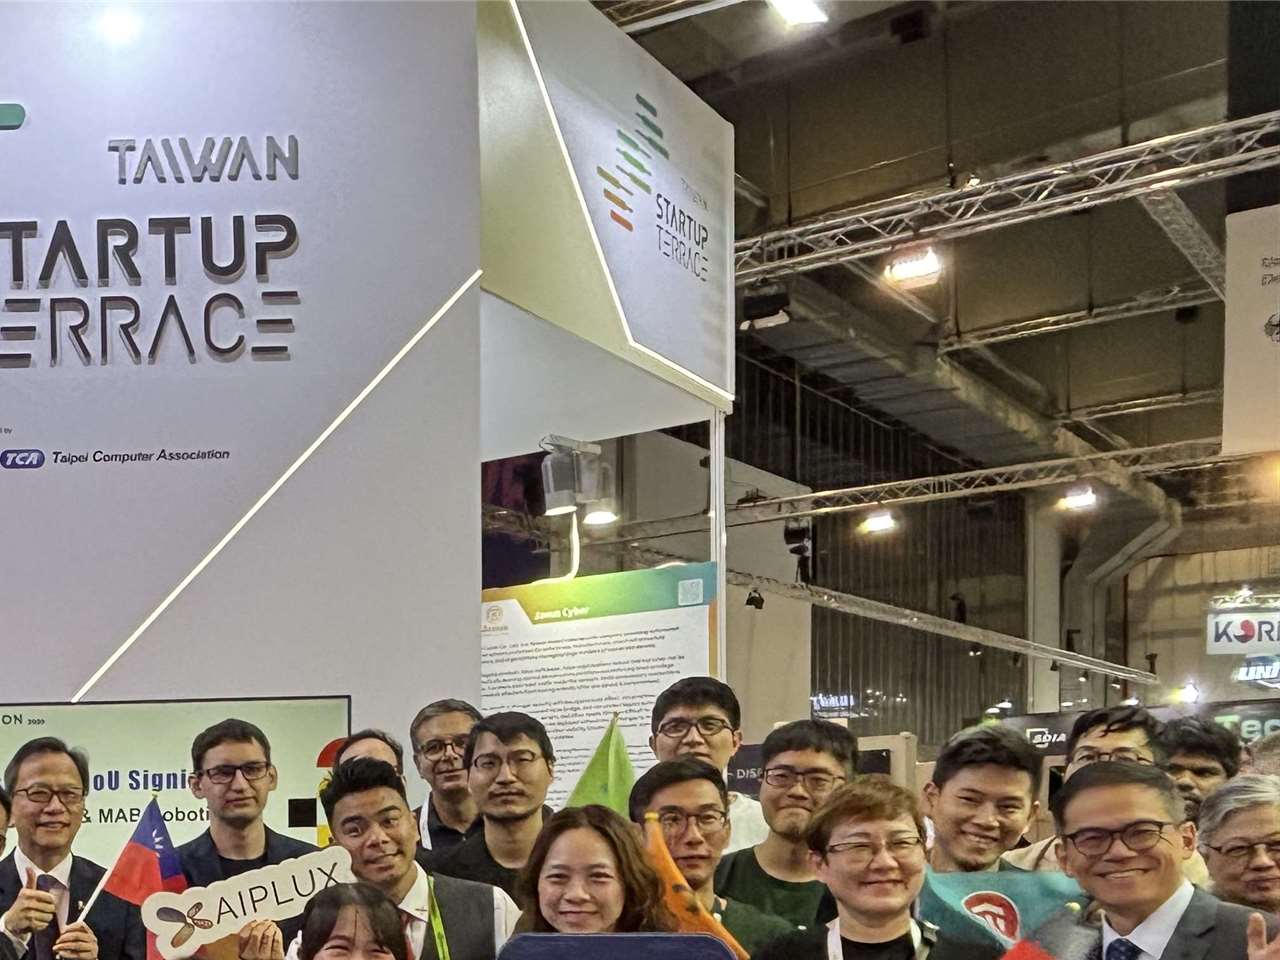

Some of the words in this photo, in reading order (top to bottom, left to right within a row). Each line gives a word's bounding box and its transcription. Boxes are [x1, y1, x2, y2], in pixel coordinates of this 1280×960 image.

[107, 134, 299, 185] TAIWAN
[656, 192, 709, 250] STARTUP
[656, 224, 708, 282] TERRACE
[4, 452, 42, 466] TCA
[52, 450, 88, 465] Taipei
[92, 449, 154, 464] Computer
[156, 448, 231, 462] Association
[1214, 618, 1280, 643] KOR
[128, 769, 190, 794] Signi
[163, 806, 210, 823] oboti
[216, 862, 340, 925] AIPLUX
